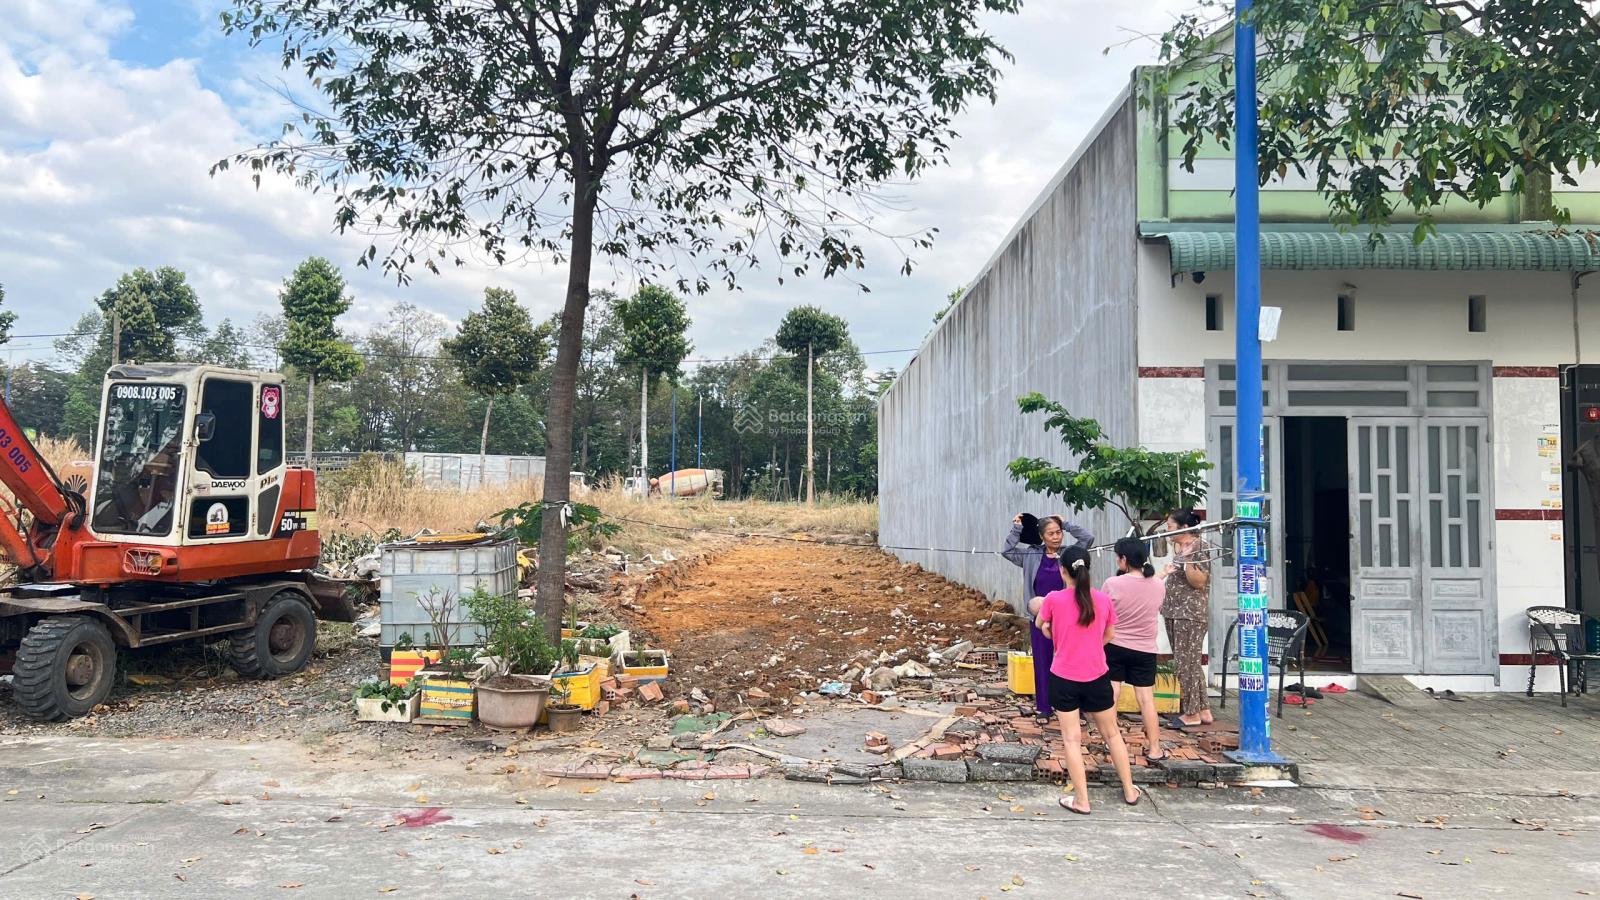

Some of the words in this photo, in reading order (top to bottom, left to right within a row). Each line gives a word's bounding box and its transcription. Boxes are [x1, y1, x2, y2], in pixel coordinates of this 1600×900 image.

[117, 386, 157, 399] 0908.103
[159, 387, 176, 400] 005
[8, 447, 31, 473] 005
